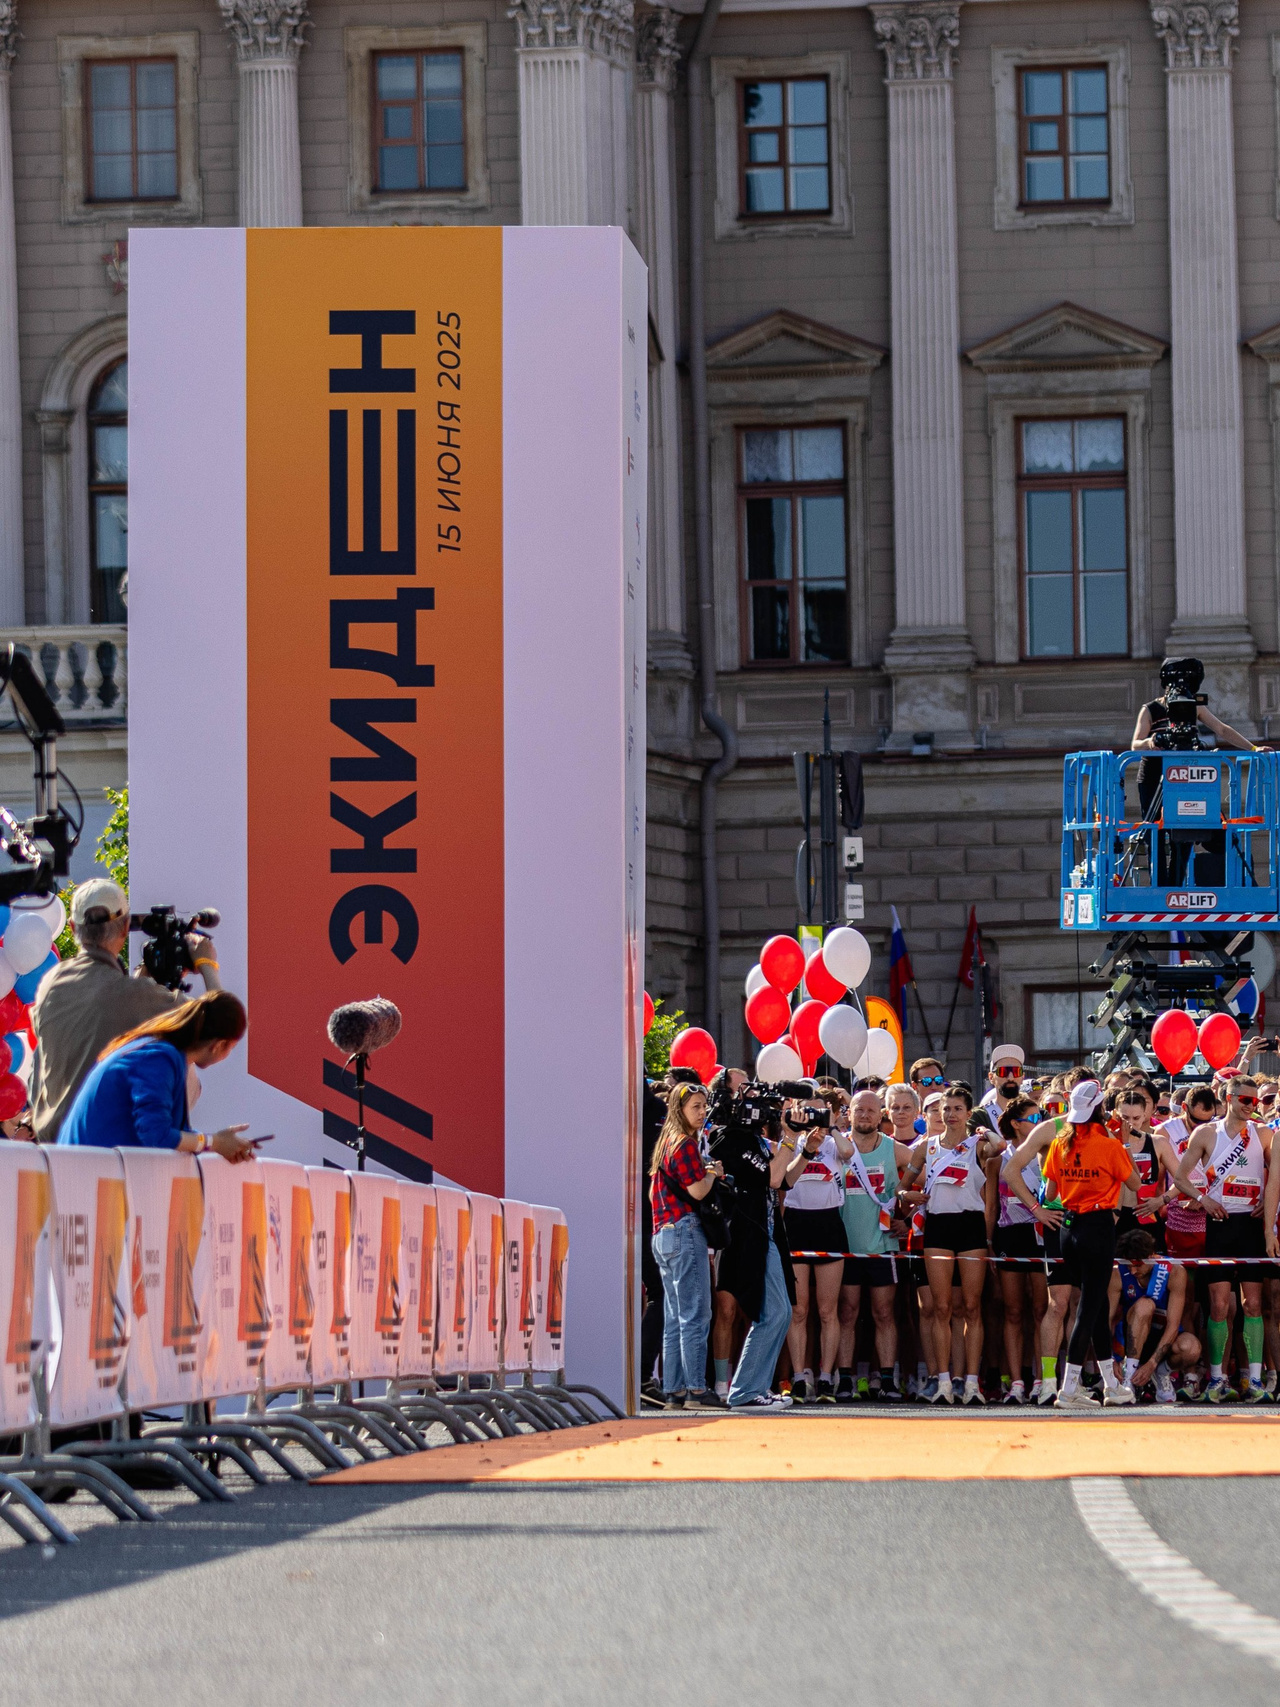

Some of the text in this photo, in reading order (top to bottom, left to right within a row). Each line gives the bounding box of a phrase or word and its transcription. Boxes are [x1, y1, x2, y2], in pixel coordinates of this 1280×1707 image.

[437, 310, 462, 555] 15 ИЮНЯ 2025
[329, 309, 435, 967] ЭКИДЕН
[1169, 769, 1215, 780] ARLIFT
[1169, 895, 1214, 906] ARLIFT
[1217, 1136, 1250, 1175] ЭКИДЕН
[1060, 1168, 1100, 1178] ЭКИДЕН
[1226, 1185, 1256, 1197] 423-1
